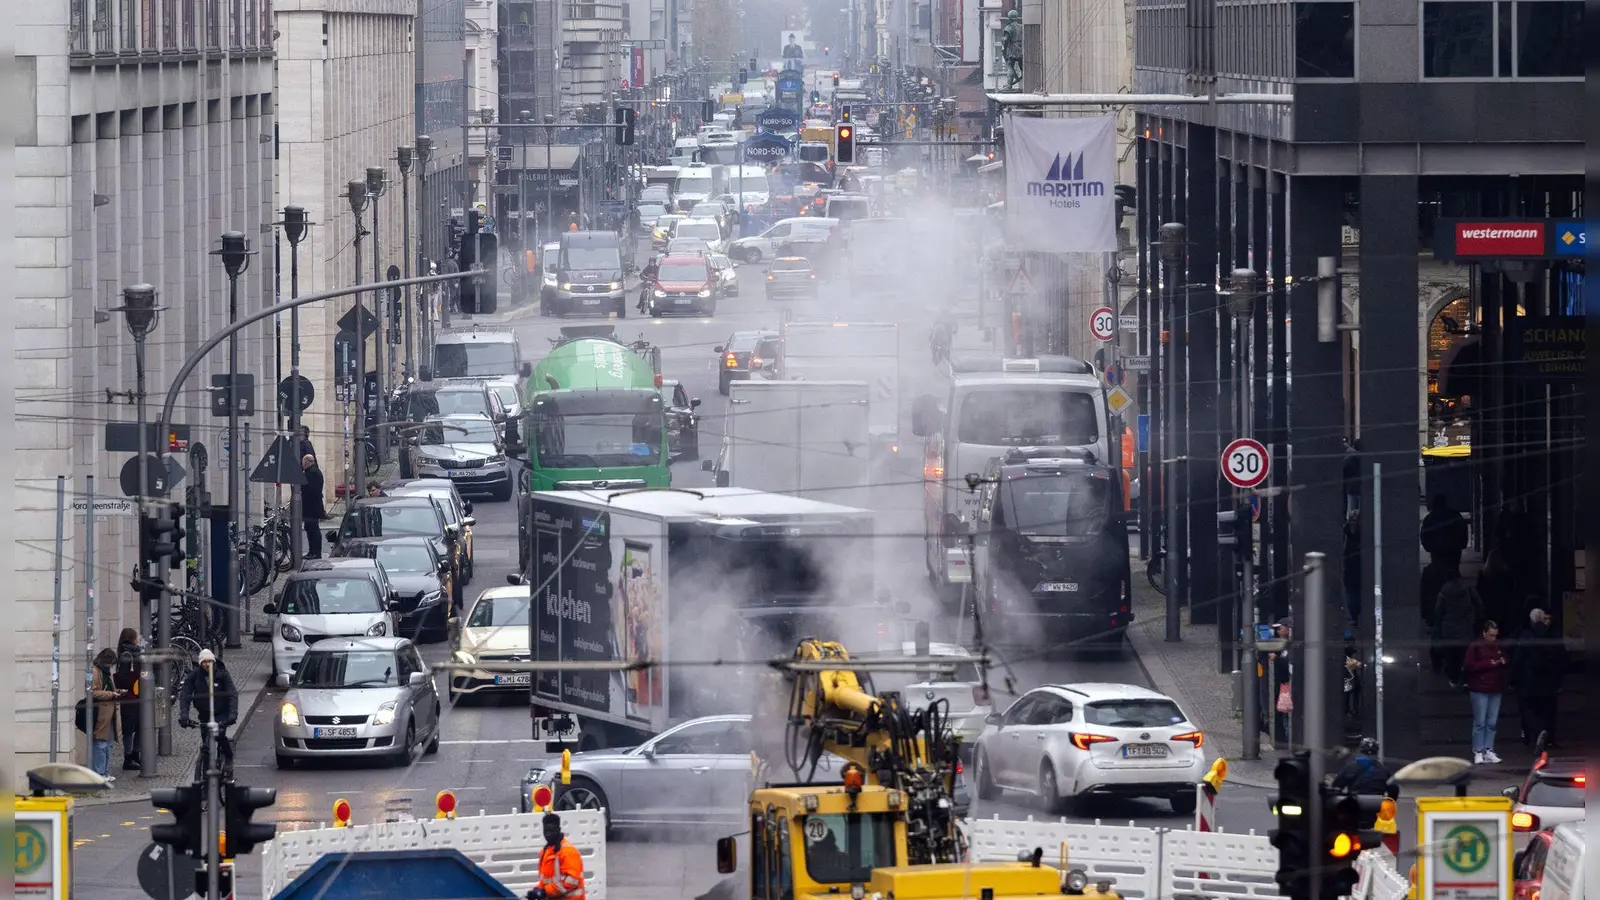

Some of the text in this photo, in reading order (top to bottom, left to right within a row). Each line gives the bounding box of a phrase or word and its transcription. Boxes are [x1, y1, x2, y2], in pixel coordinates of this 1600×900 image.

[762, 117, 793, 125] NORD-SÜD
[747, 146, 786, 156] NORD-SÜD
[518, 173, 548, 181] ALERIE
[1027, 181, 1104, 197] MARITIM
[1050, 199, 1081, 208] Hotels
[1462, 227, 1538, 239] westermann
[1096, 316, 1113, 332] 30
[1233, 452, 1259, 474] 30
[546, 584, 591, 624] kuchen
[809, 822, 824, 838] 20
[1455, 835, 1477, 862] H
